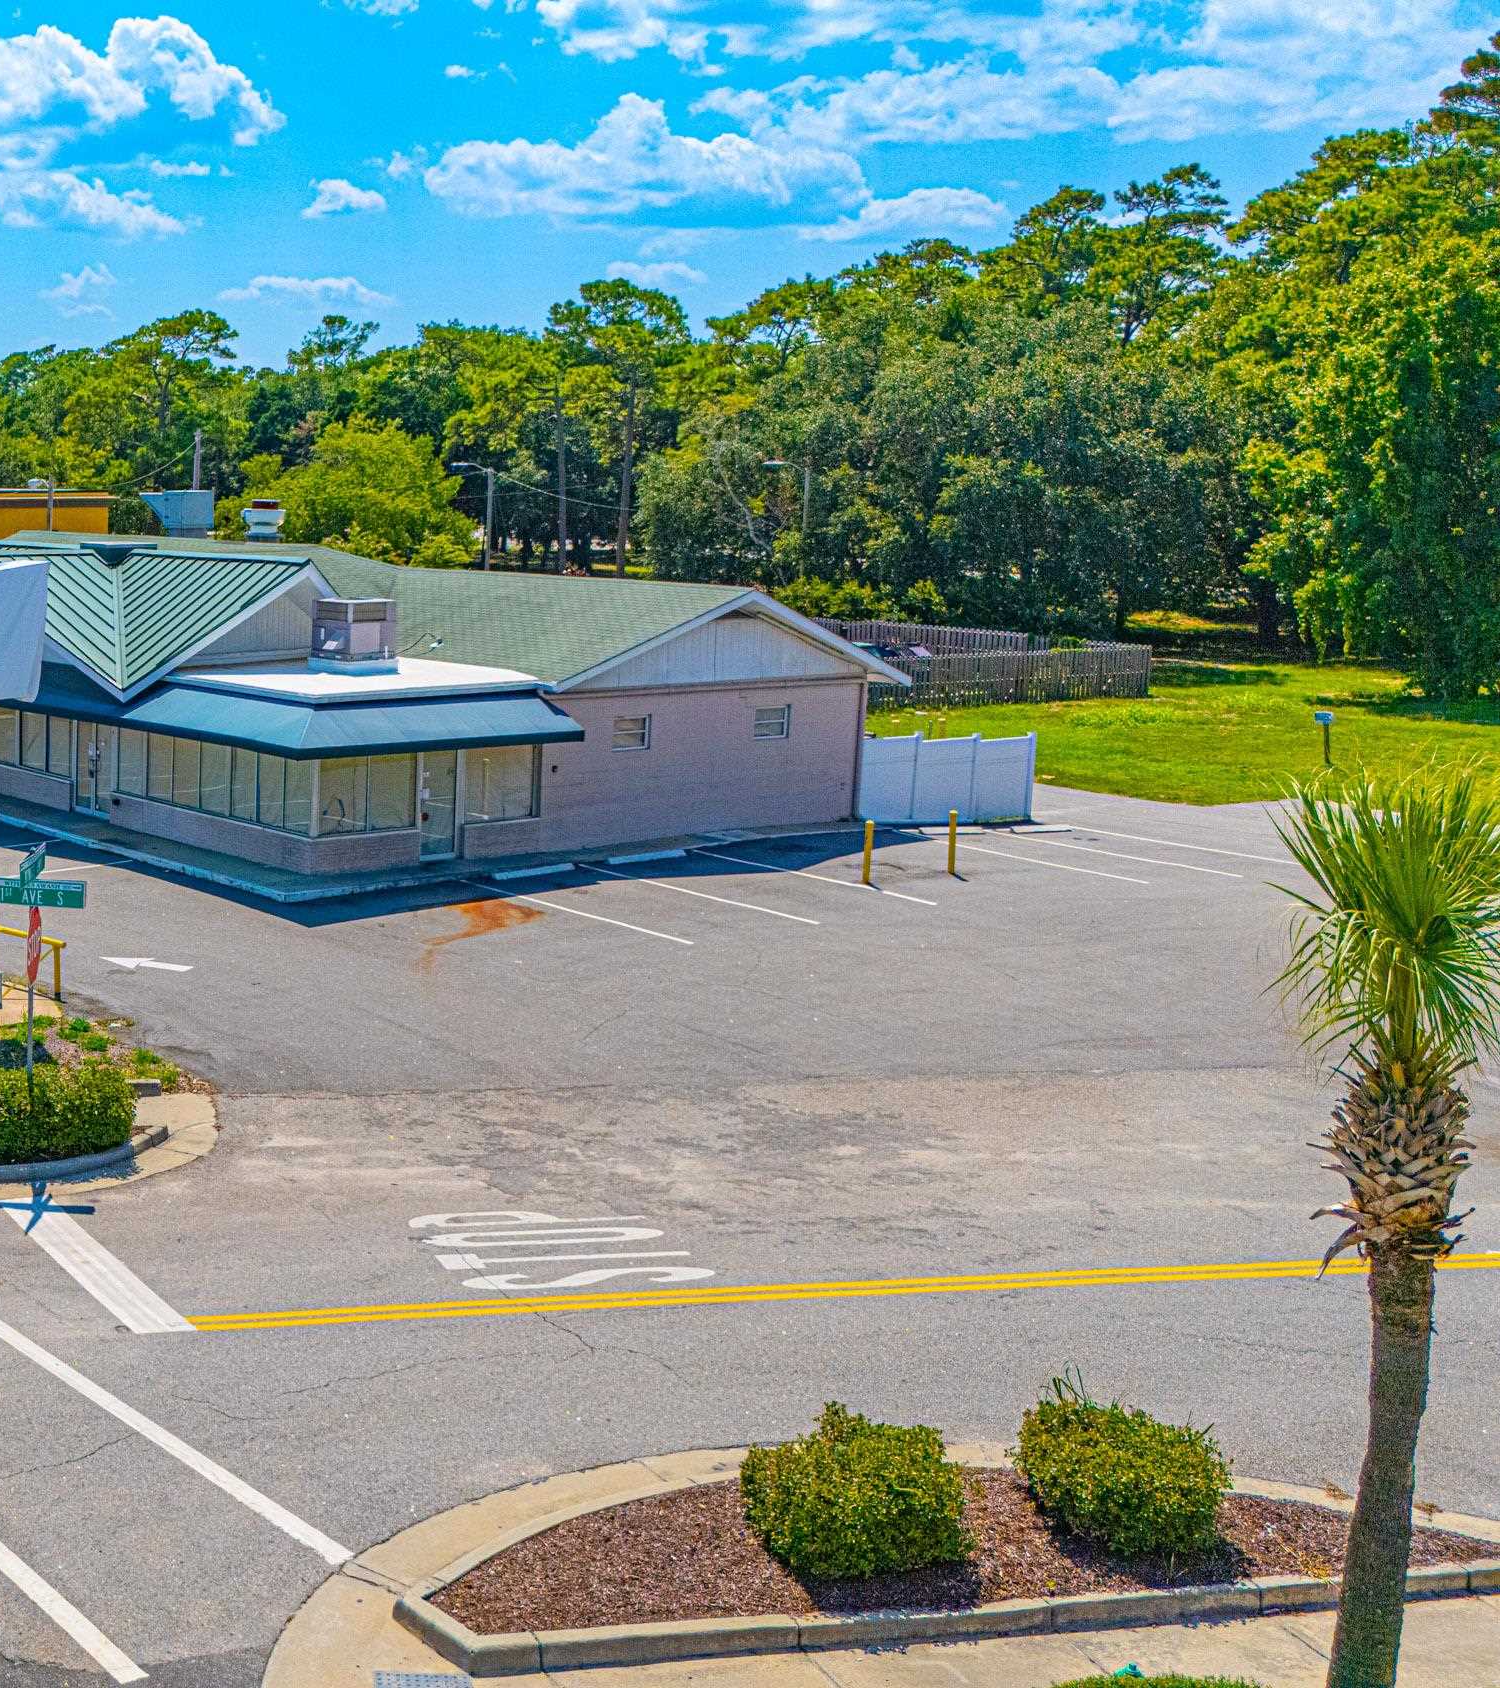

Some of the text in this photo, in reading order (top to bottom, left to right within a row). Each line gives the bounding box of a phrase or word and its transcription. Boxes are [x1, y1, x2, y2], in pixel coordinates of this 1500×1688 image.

[21, 889, 44, 905] AVE
[56, 891, 64, 906] S
[408, 1210, 716, 1290] STOP
